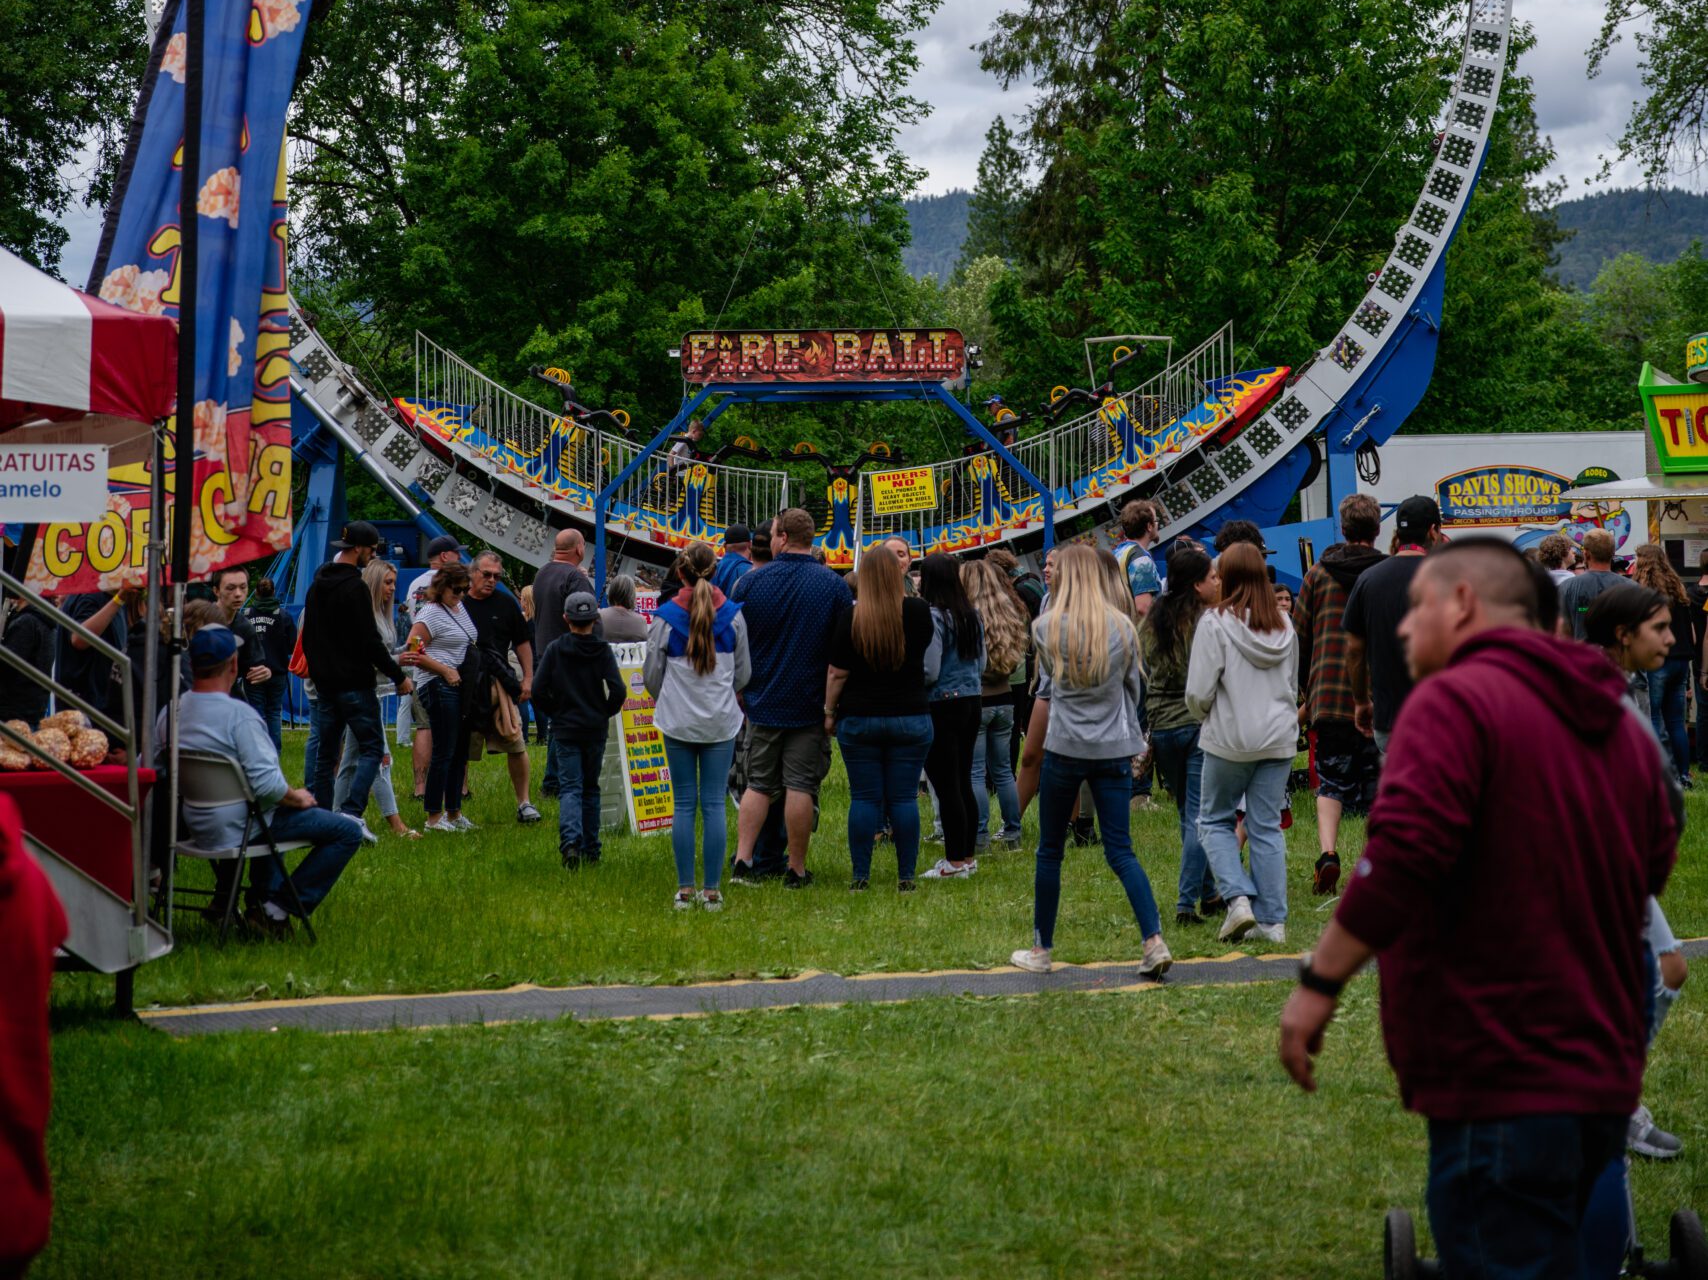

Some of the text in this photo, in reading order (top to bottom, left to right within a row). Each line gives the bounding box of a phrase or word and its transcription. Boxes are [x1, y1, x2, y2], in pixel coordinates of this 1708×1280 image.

[833, 332, 957, 372] BALL
[0, 452, 96, 472] ATUITAS
[877, 470, 928, 482] RIDERS
[1584, 469, 1608, 478] RODEO
[892, 479, 915, 488] NO
[1448, 473, 1562, 496] DAVIS SHOWS
[879, 498, 904, 506] ALLOWED
[1449, 494, 1562, 507] NORTHWEST
[1454, 507, 1557, 516] PASSING THROUGH
